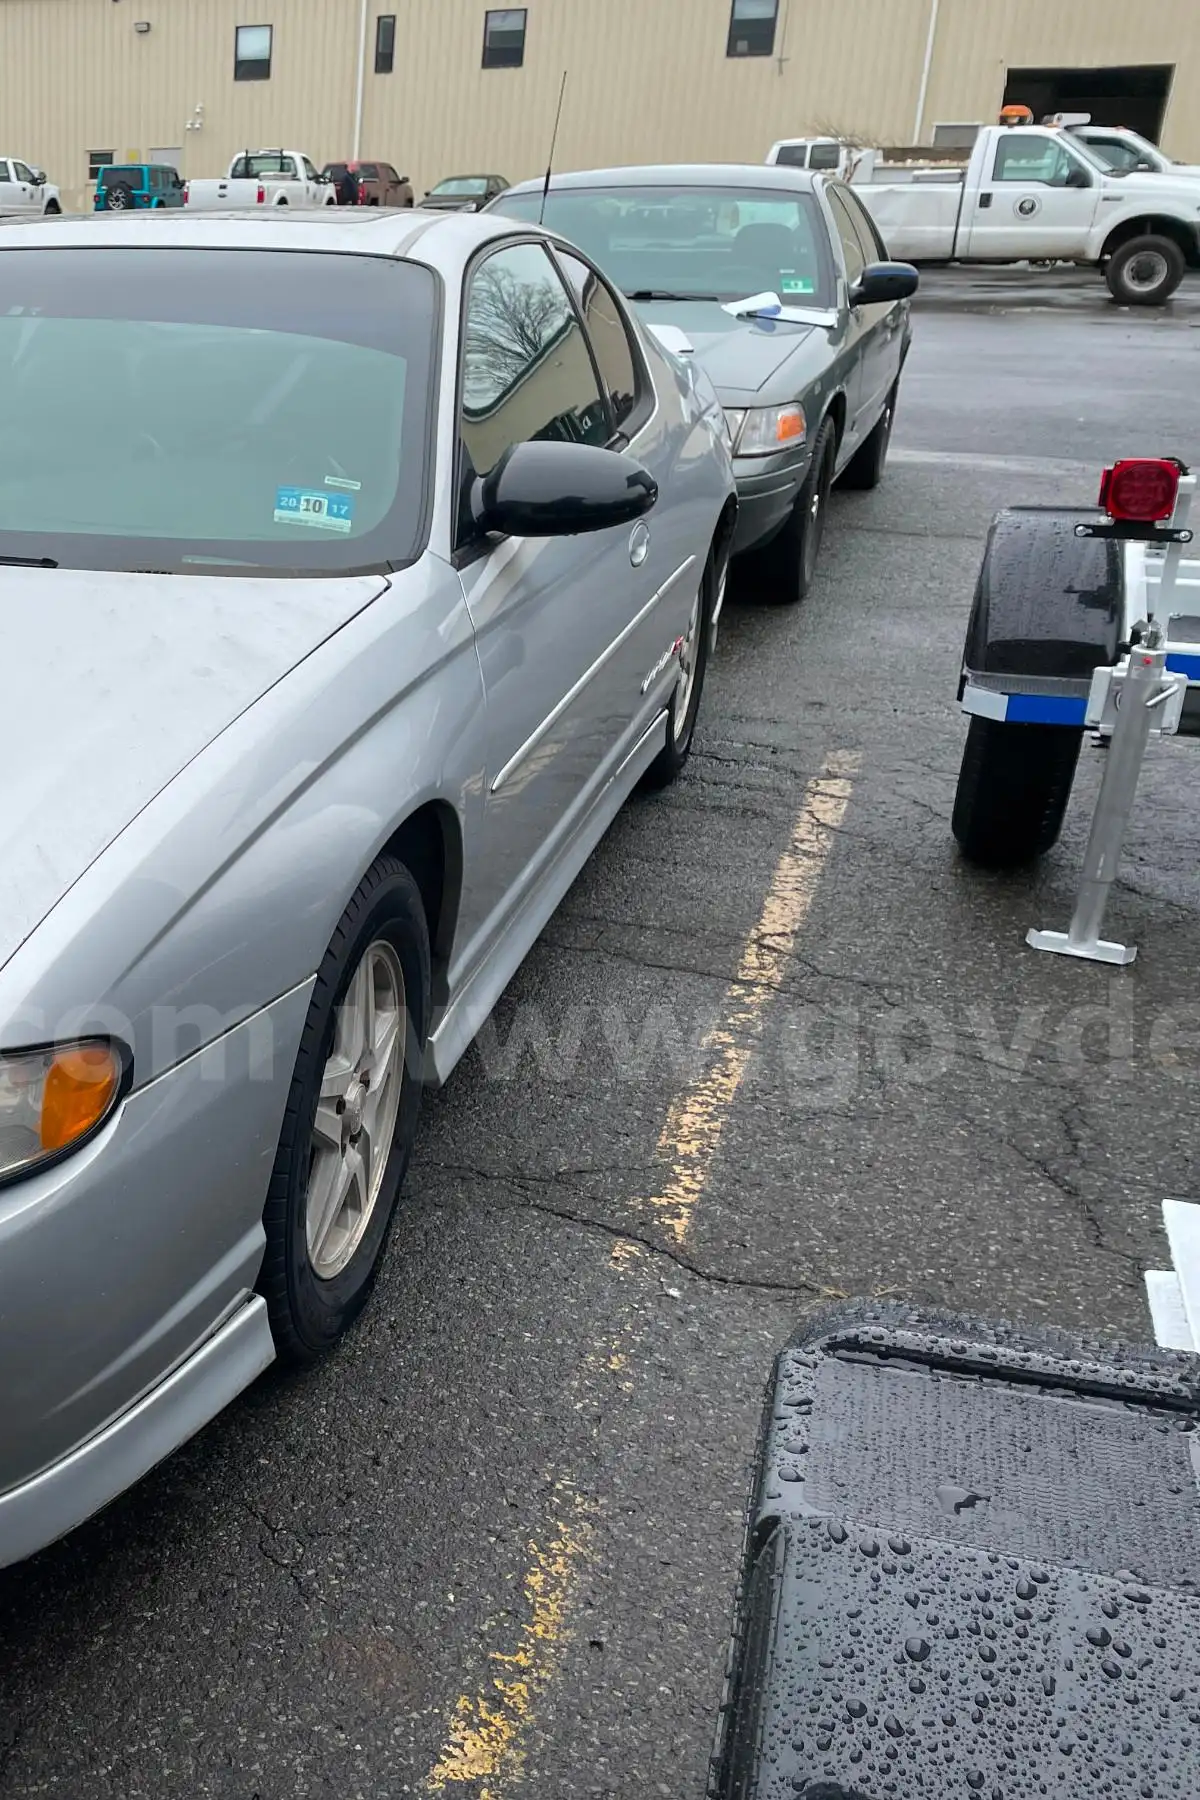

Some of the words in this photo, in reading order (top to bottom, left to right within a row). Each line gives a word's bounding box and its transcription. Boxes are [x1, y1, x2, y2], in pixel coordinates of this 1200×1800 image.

[280, 496, 297, 508] 20
[303, 498, 323, 514] 10
[331, 504, 349, 516] 17
